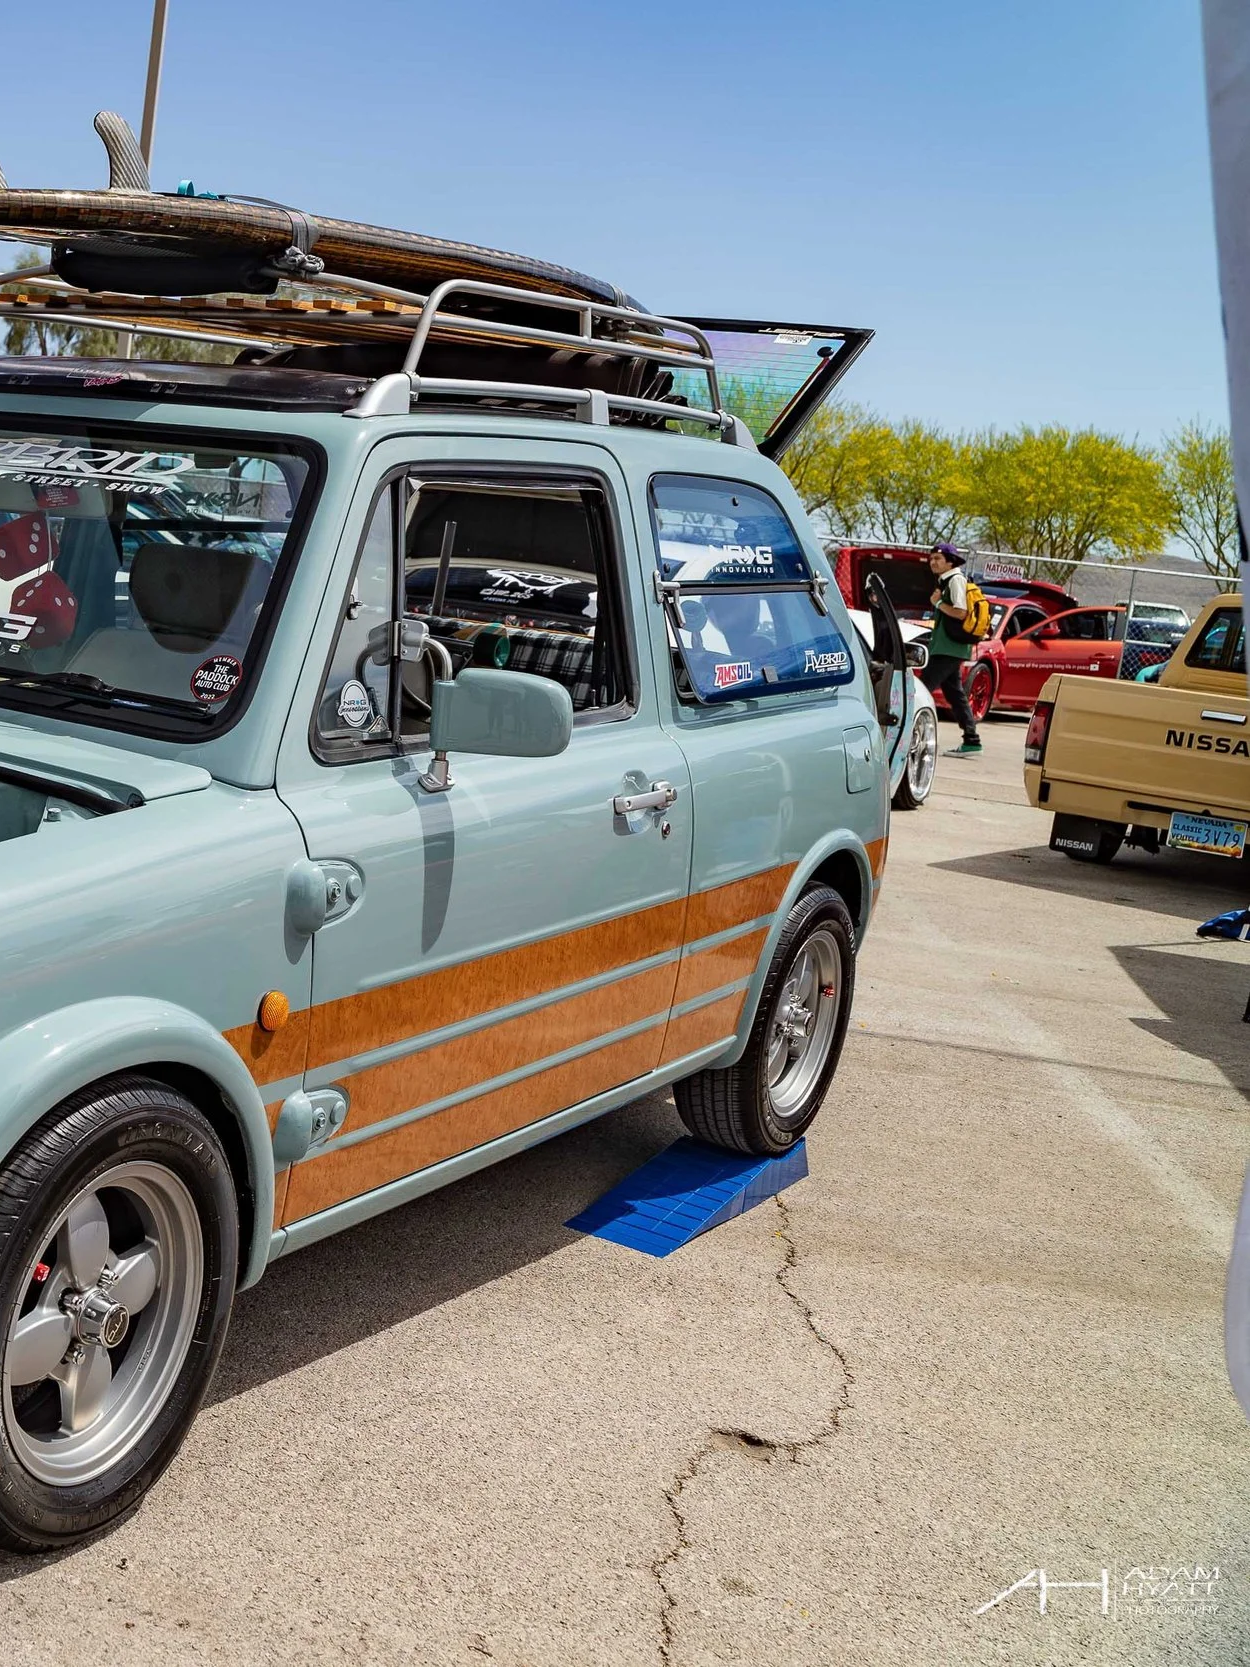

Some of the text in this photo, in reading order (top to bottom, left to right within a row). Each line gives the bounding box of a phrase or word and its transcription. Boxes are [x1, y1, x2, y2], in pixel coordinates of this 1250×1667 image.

[12, 474, 89, 487] STREET
[105, 482, 170, 495] SHOW
[986, 562, 1022, 576] NATIONAL
[213, 657, 237, 666] MEMBER
[214, 664, 229, 674] THE
[717, 663, 751, 684] AMSOIL
[195, 670, 239, 685] PADDOCK
[195, 680, 230, 691] AUTO CLUB
[1165, 730, 1250, 757] NISSA
[1173, 823, 1203, 834] CLASSIC
[1191, 816, 1227, 829] NEVADA
[1055, 838, 1093, 851] NISSAN
